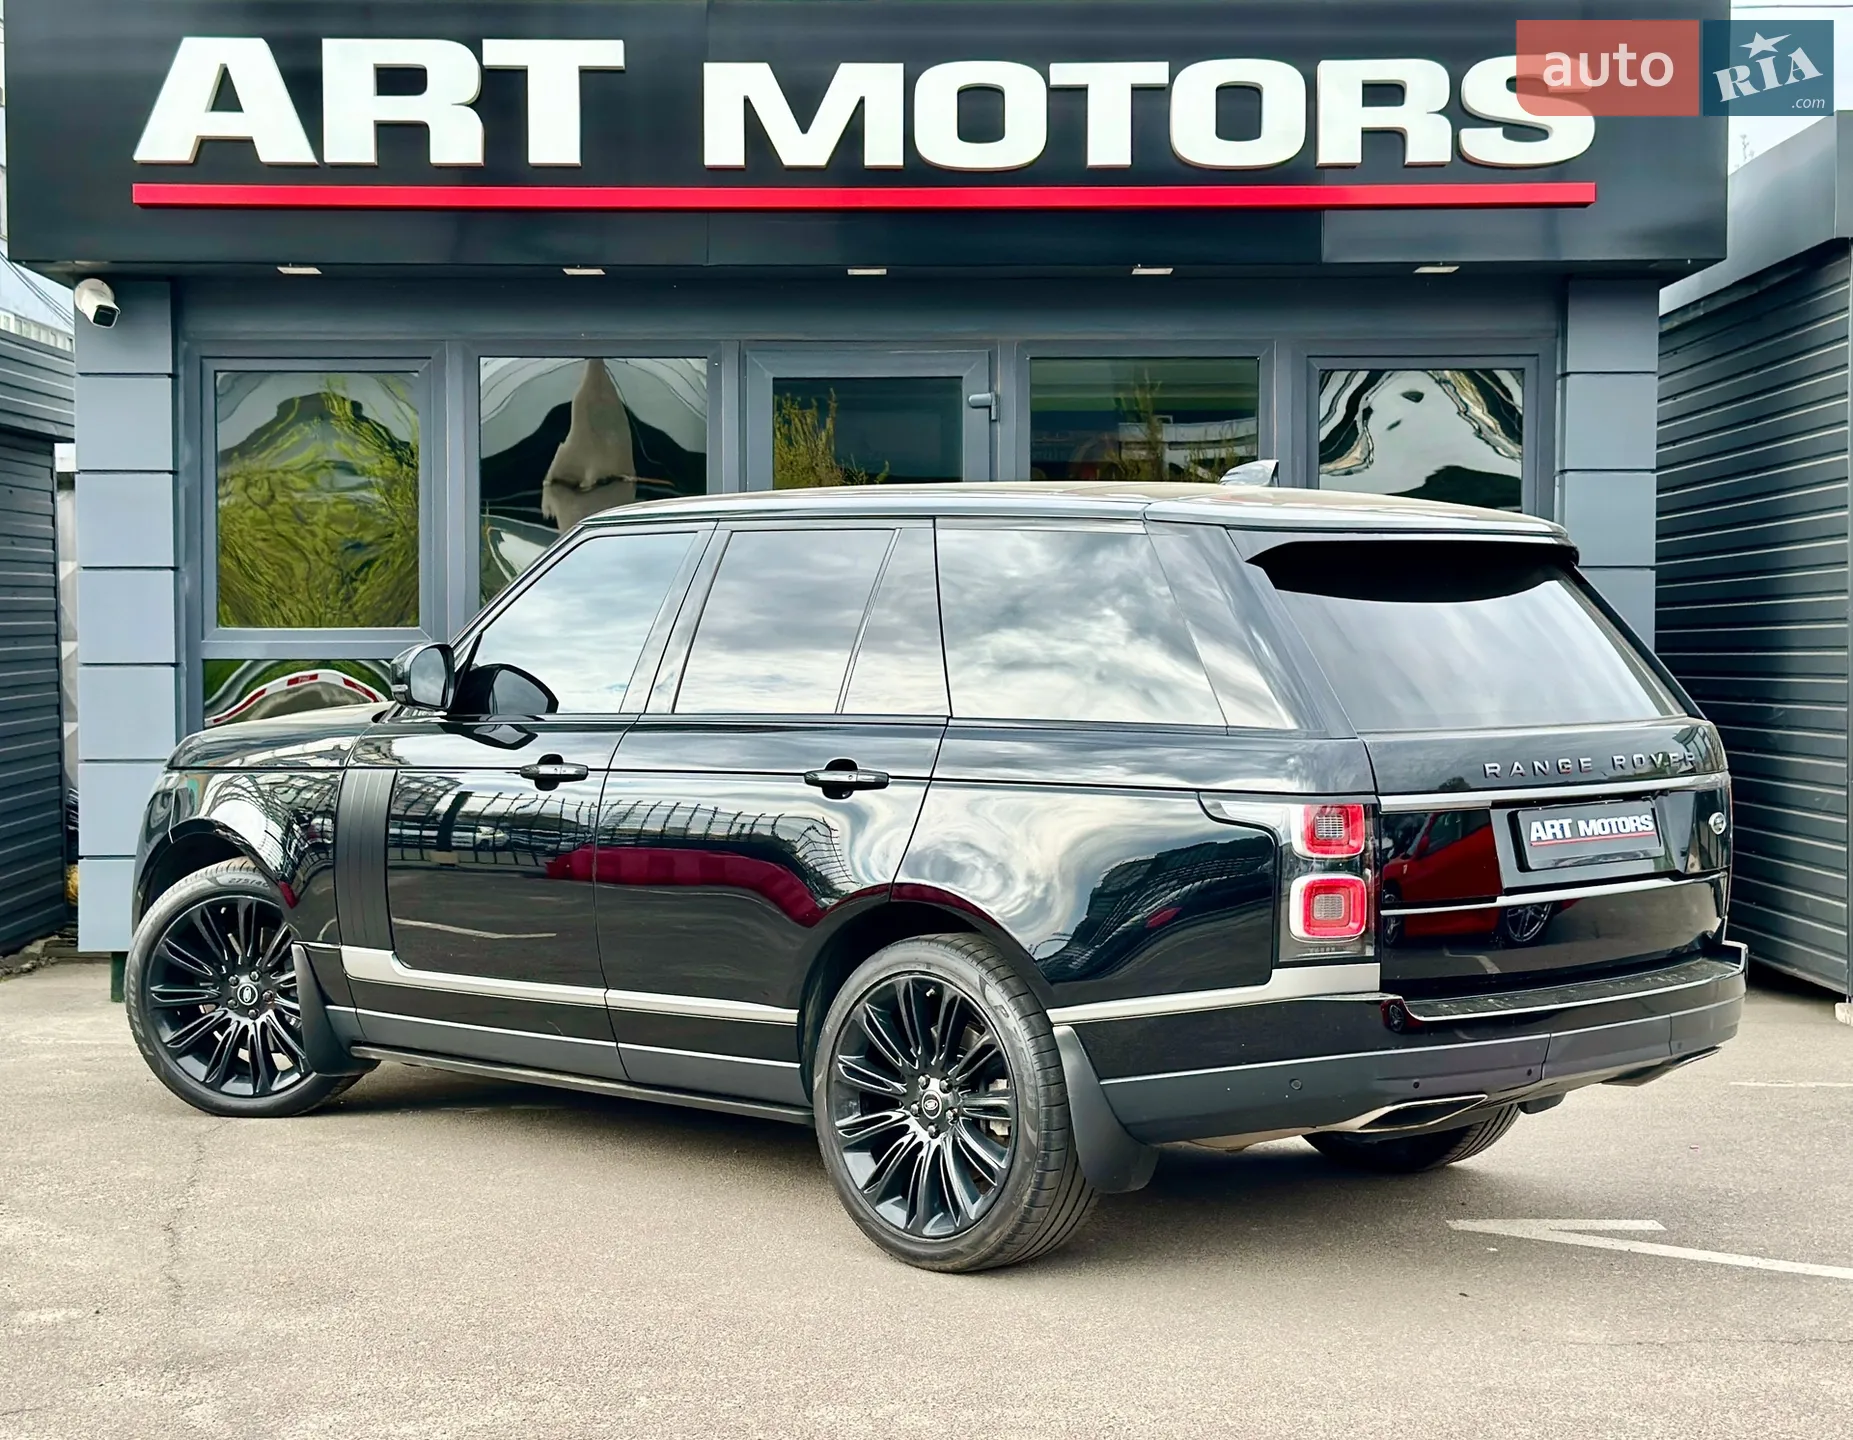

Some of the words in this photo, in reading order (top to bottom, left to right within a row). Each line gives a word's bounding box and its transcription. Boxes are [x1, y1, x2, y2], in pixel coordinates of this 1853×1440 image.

[132, 36, 625, 167] ART
[703, 55, 1596, 169] MOTORS
[1483, 756, 1594, 778] RANGE
[1611, 751, 1697, 770] ROVER
[1530, 818, 1573, 842] ART
[1577, 813, 1655, 837] MOTORS
